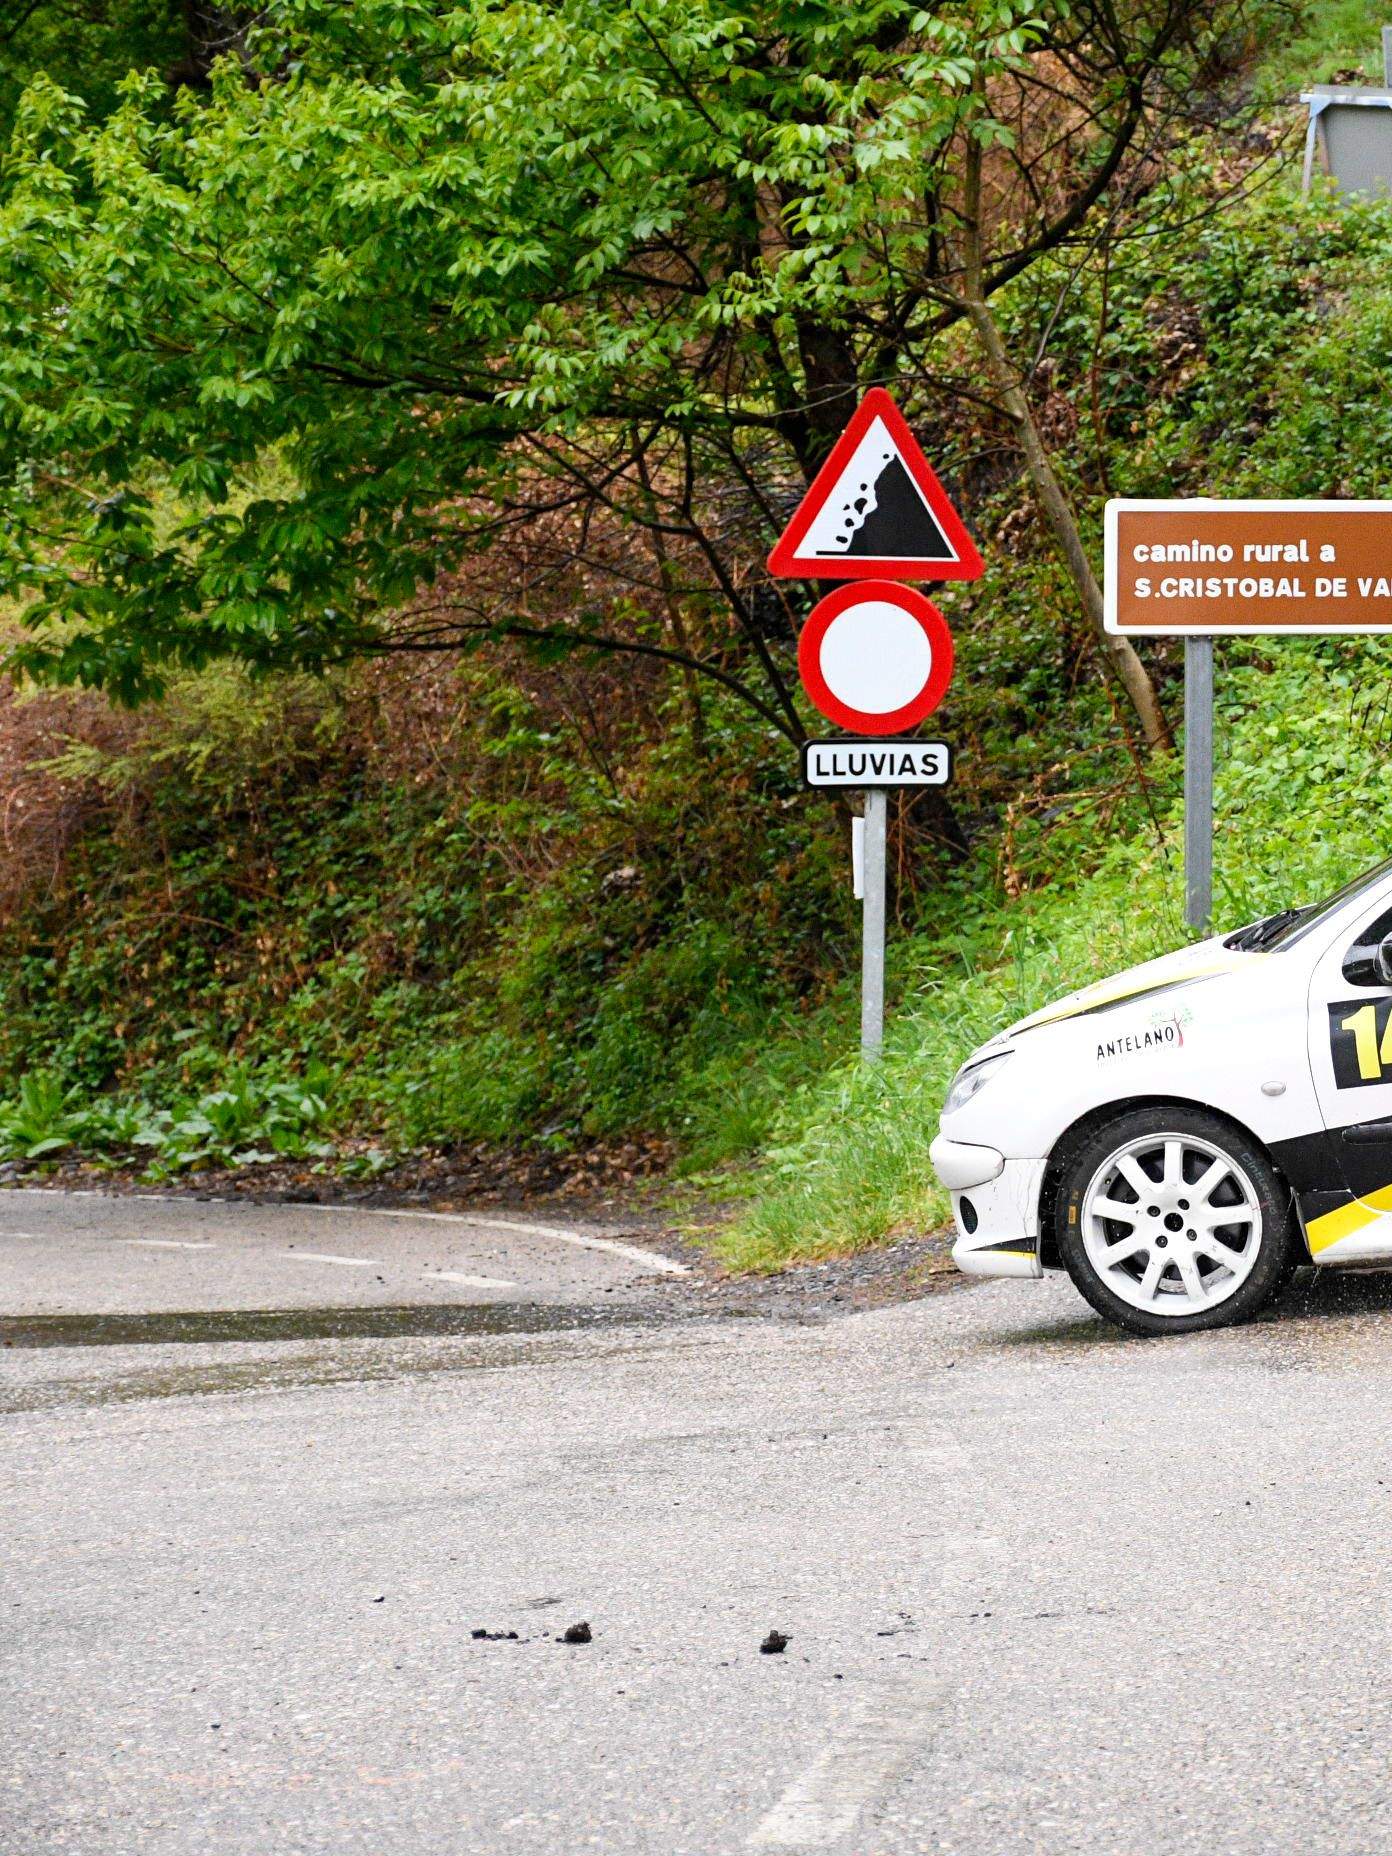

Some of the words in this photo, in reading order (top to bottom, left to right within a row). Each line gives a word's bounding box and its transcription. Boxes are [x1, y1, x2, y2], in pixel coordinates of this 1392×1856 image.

[1132, 539, 1234, 563] camino
[1243, 539, 1309, 563] rural
[1319, 544, 1336, 563] a
[1133, 577, 1306, 599] S.CRISTOBAL
[1315, 577, 1347, 598] DE
[816, 753, 939, 776] LLUVIAS
[1096, 1026, 1174, 1061] ANTELANO
